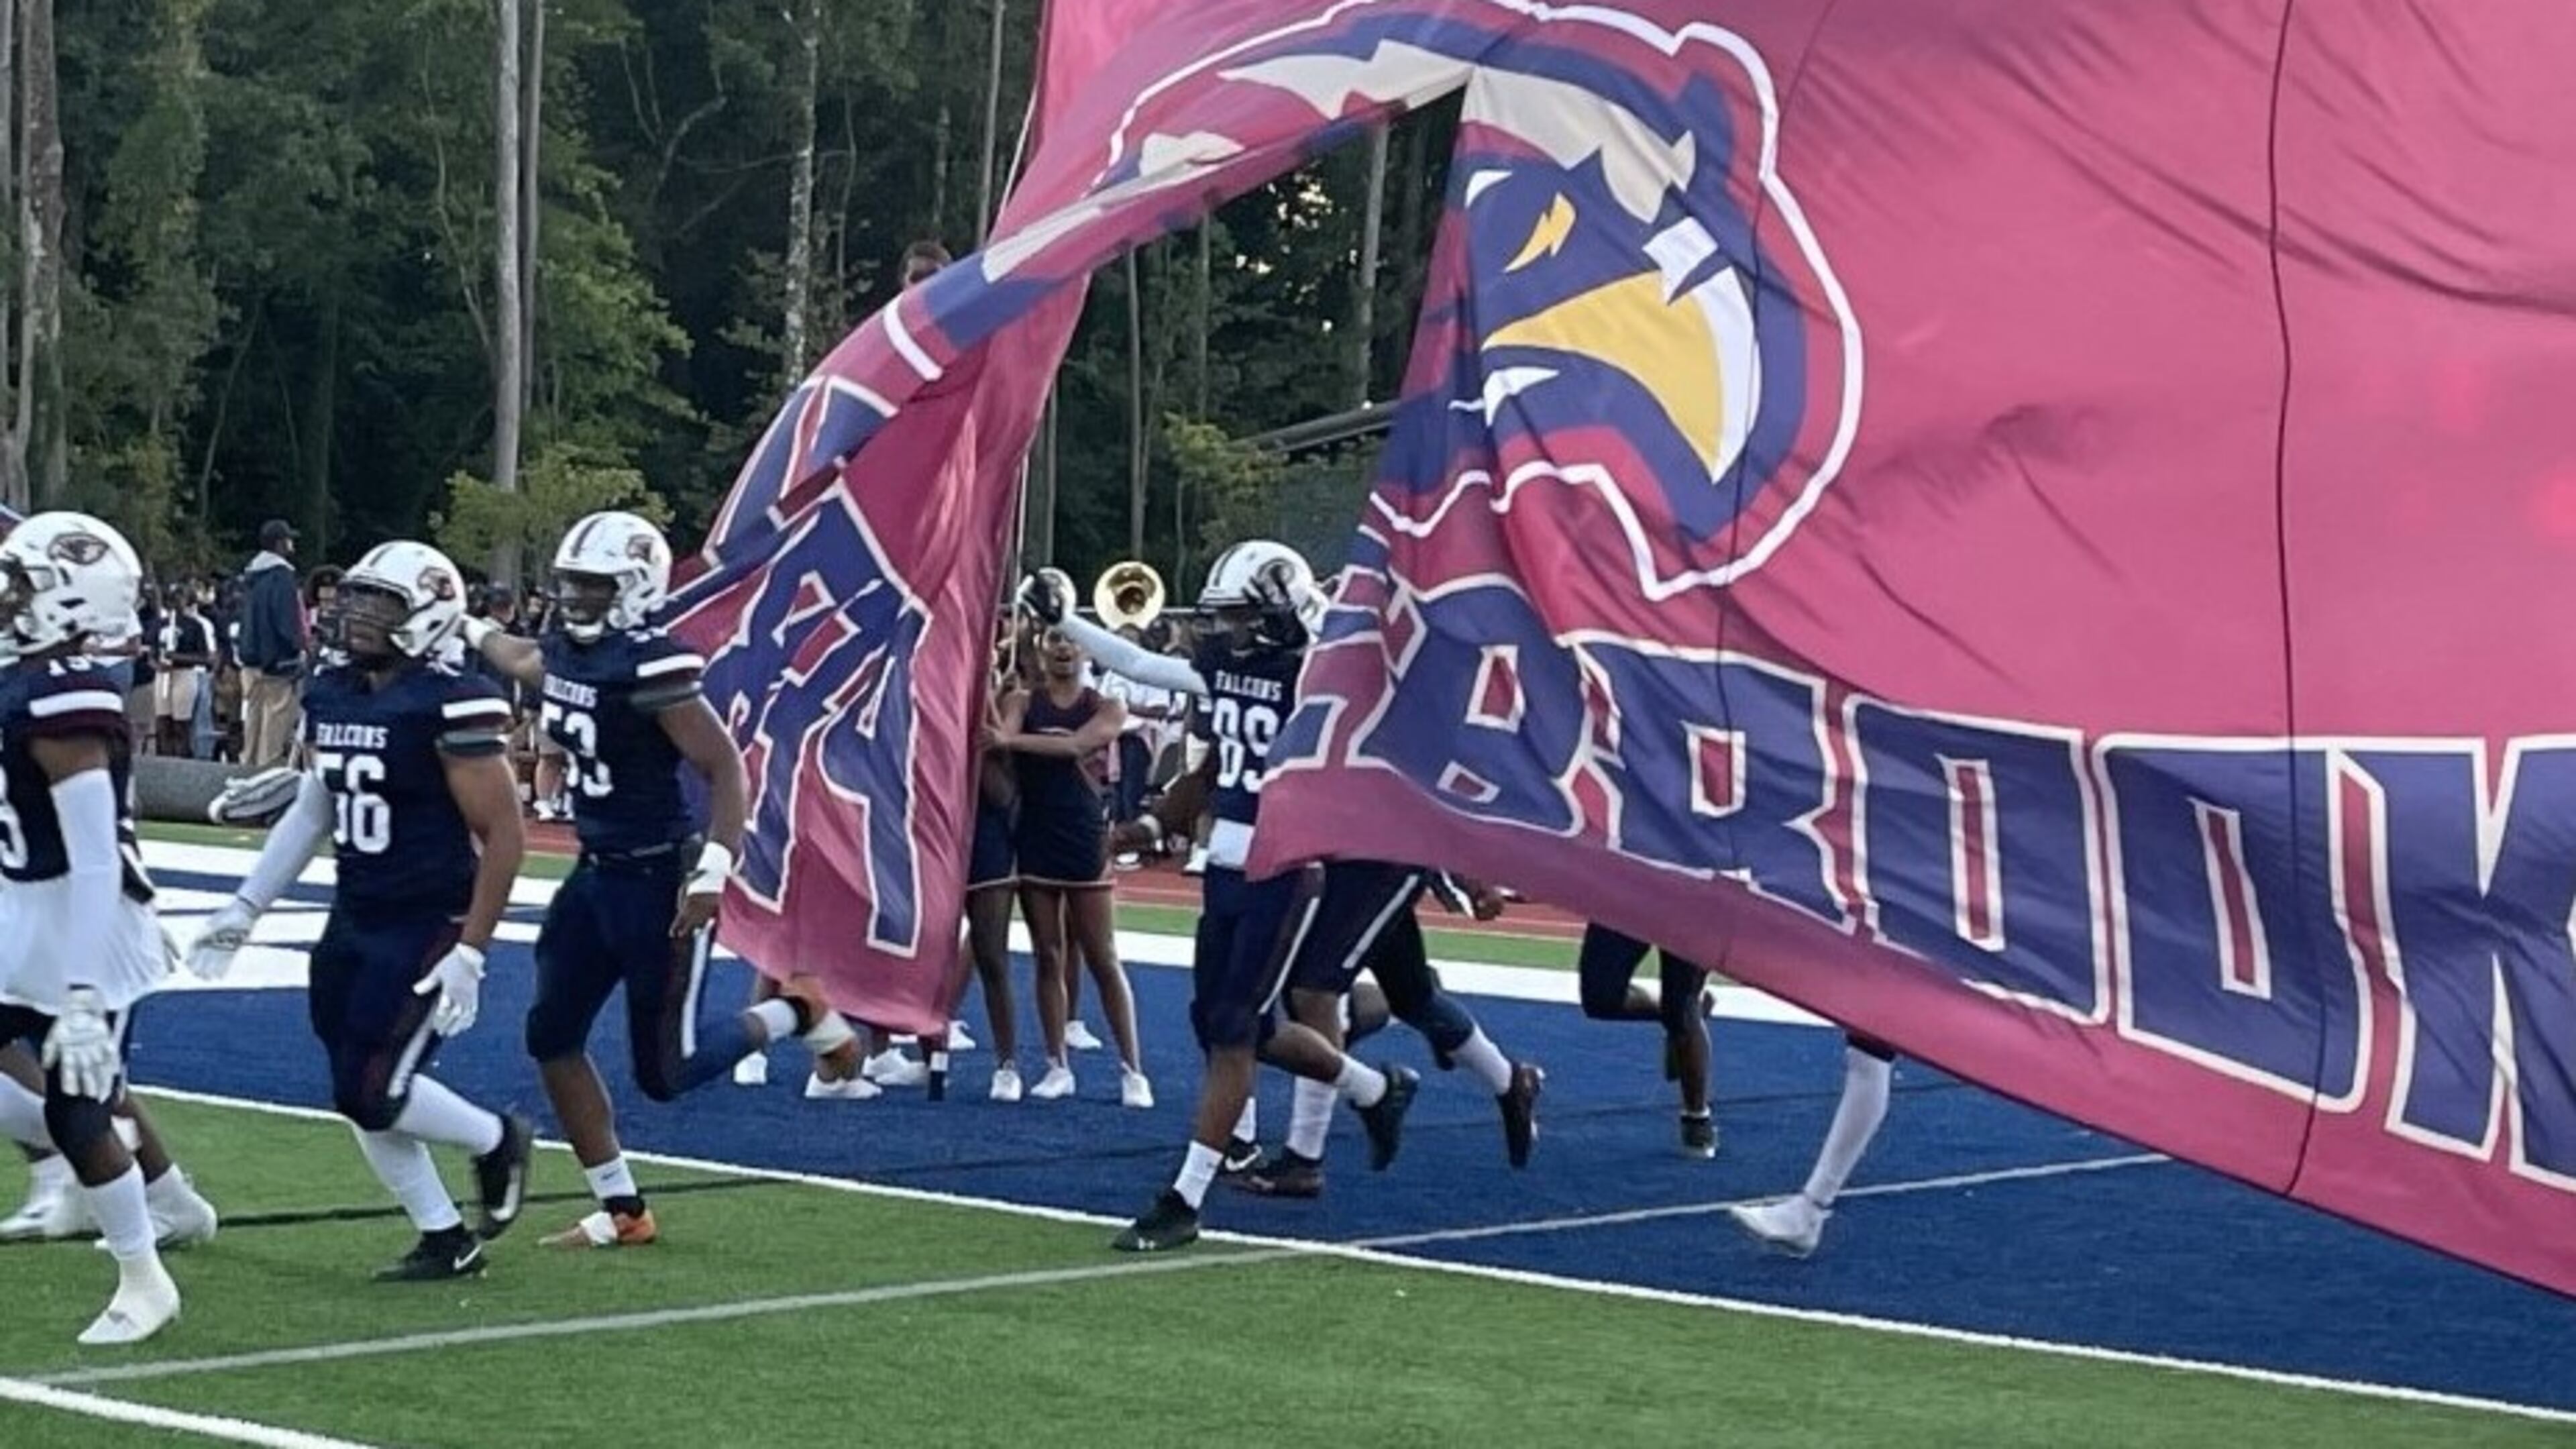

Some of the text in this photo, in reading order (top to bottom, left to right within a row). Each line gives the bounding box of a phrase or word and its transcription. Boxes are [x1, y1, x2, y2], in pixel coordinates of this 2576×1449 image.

[1216, 669, 1282, 702] FALCONS
[316, 722, 388, 749] FALCONS
[540, 700, 614, 796] 53
[314, 752, 391, 854] 56
